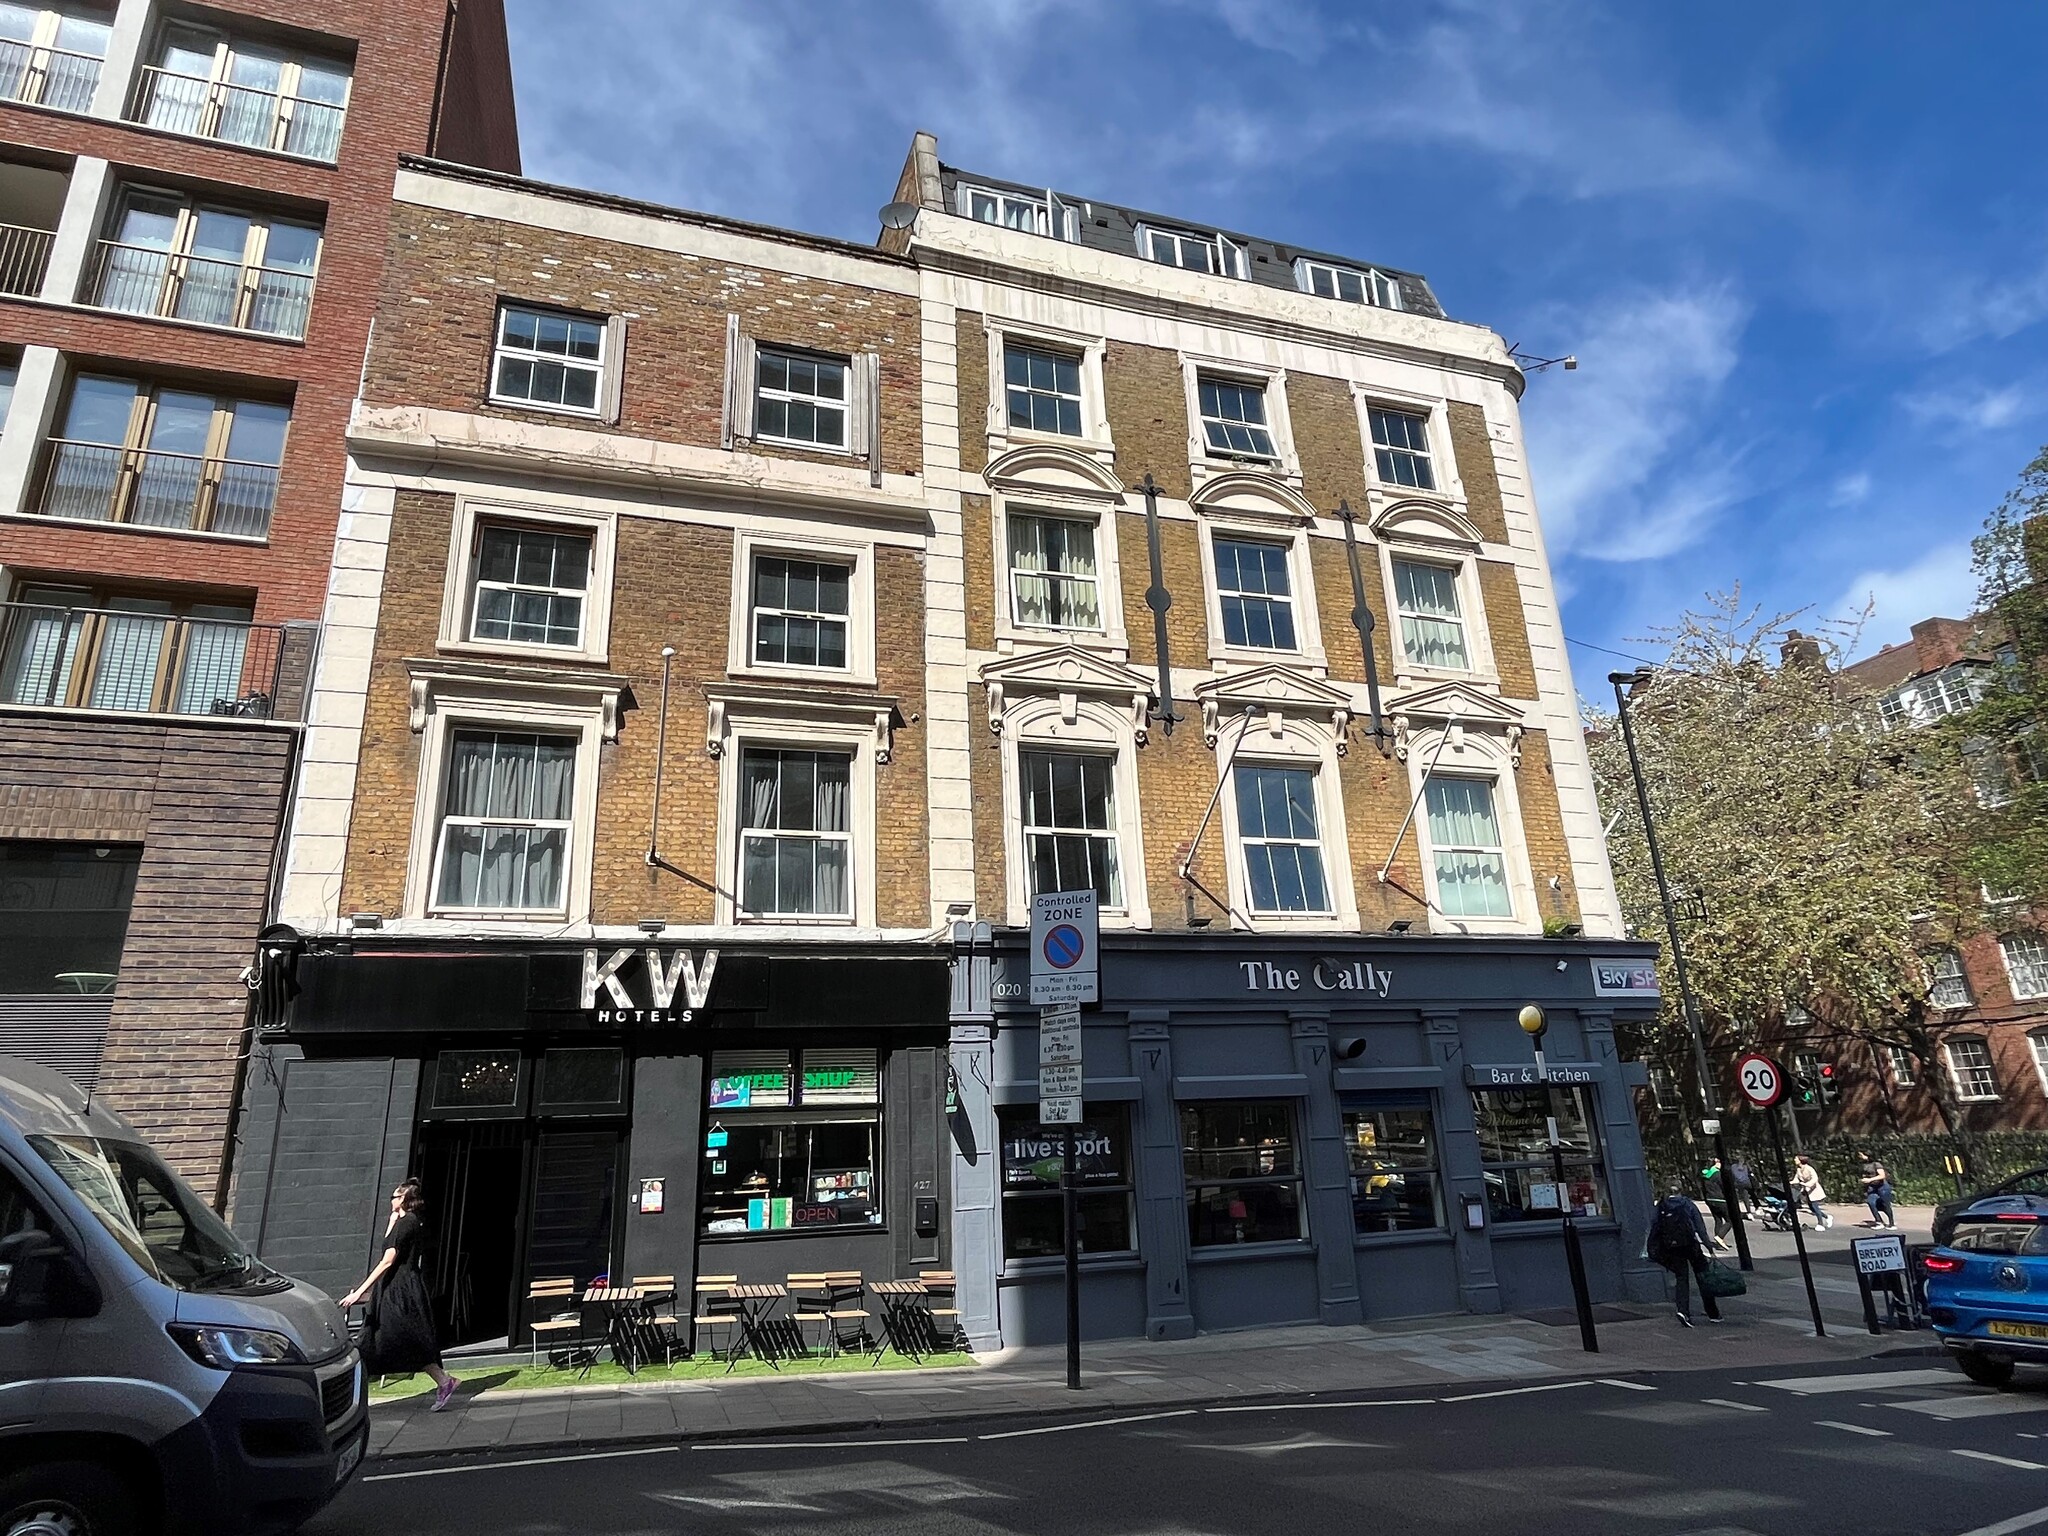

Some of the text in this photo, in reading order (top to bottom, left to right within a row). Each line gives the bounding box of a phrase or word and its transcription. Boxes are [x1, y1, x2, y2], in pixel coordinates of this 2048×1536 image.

[1036, 894, 1092, 908] Controlled
[1044, 908, 1083, 921] ZONE
[581, 948, 720, 1009] KW
[1239, 961, 1393, 998] The Cally
[1601, 969, 1628, 988] sky
[997, 984, 1022, 996] 020
[1034, 985, 1050, 993] 8.30
[598, 1010, 693, 1022] HOTELS
[1491, 1067, 1590, 1084] Bar & itchen
[1744, 1069, 1774, 1090] 20
[1014, 1138, 1052, 1159] live
[913, 1181, 931, 1190] 427
[795, 1207, 837, 1221] OPEN
[1858, 1246, 1900, 1260] BREWERY
[1861, 1259, 1887, 1271] ROAD
